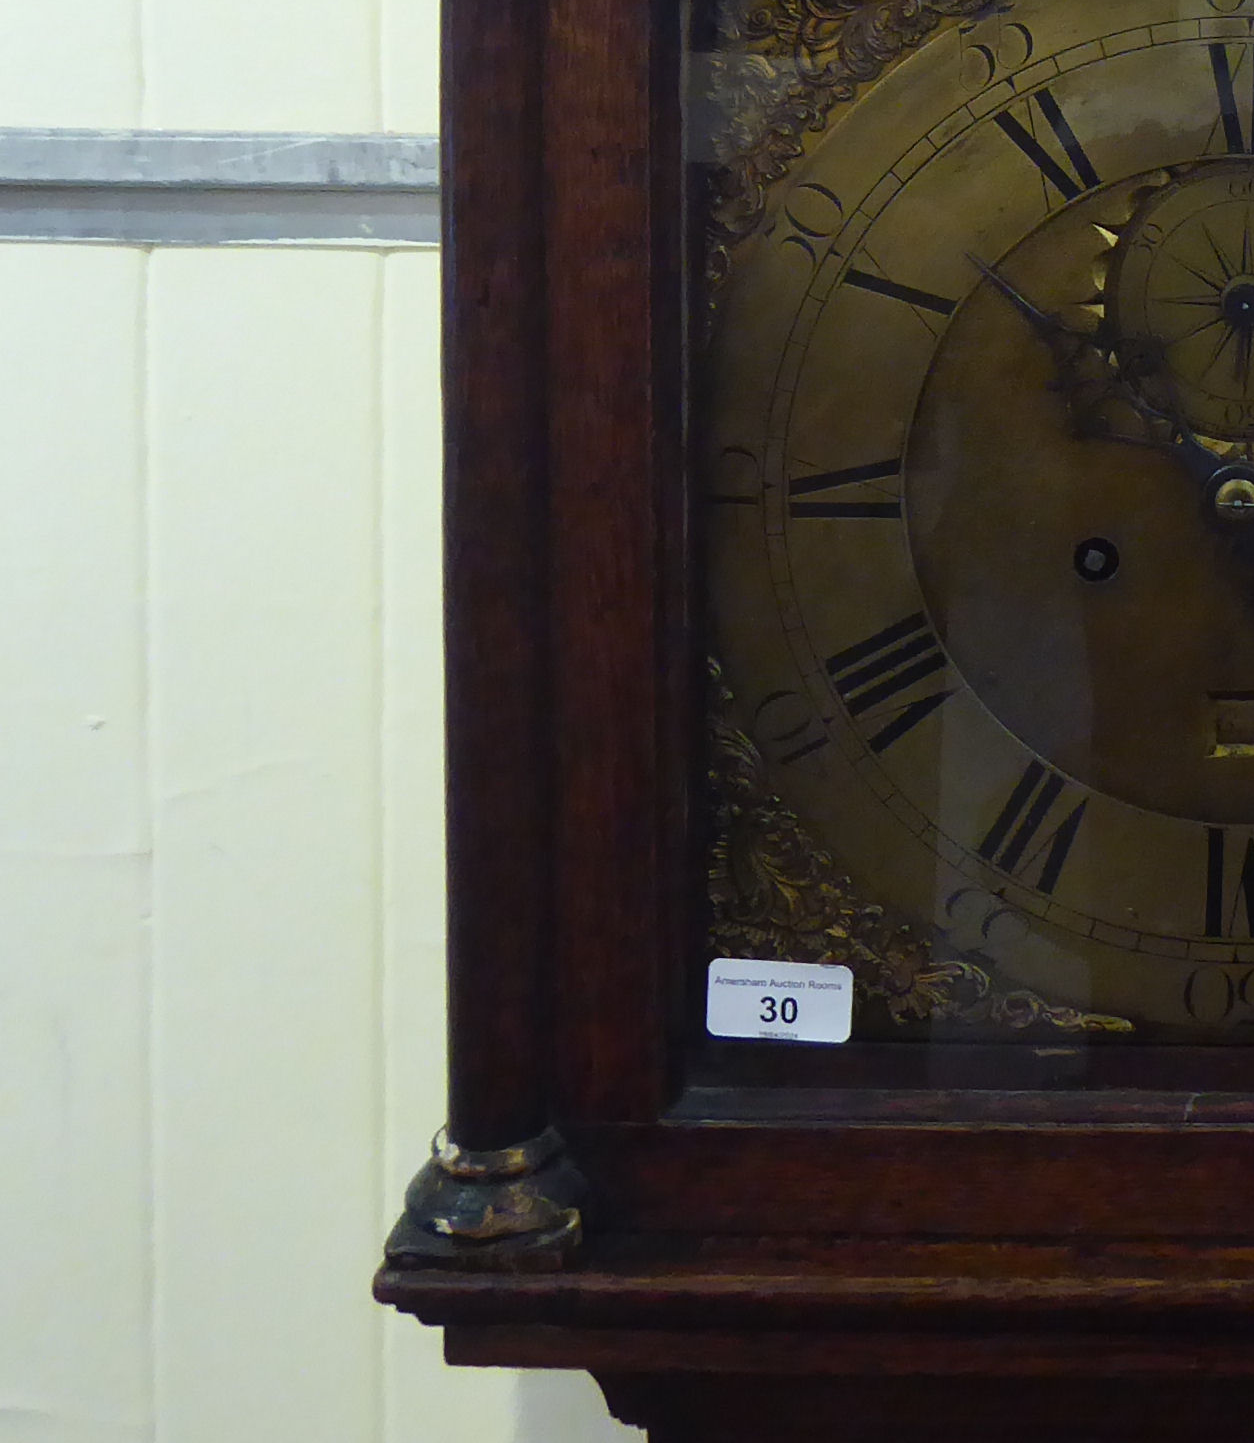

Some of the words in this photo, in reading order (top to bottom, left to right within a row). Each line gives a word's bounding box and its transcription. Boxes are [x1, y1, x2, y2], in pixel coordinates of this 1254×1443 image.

[993, 85, 1102, 214] XI
[837, 244, 962, 342] X
[776, 457, 905, 519] IX
[824, 610, 965, 757] VIII
[976, 757, 1090, 896] VII
[759, 995, 798, 1024] 30
[769, 978, 806, 989] Auction
[808, 980, 842, 991] Rooms
